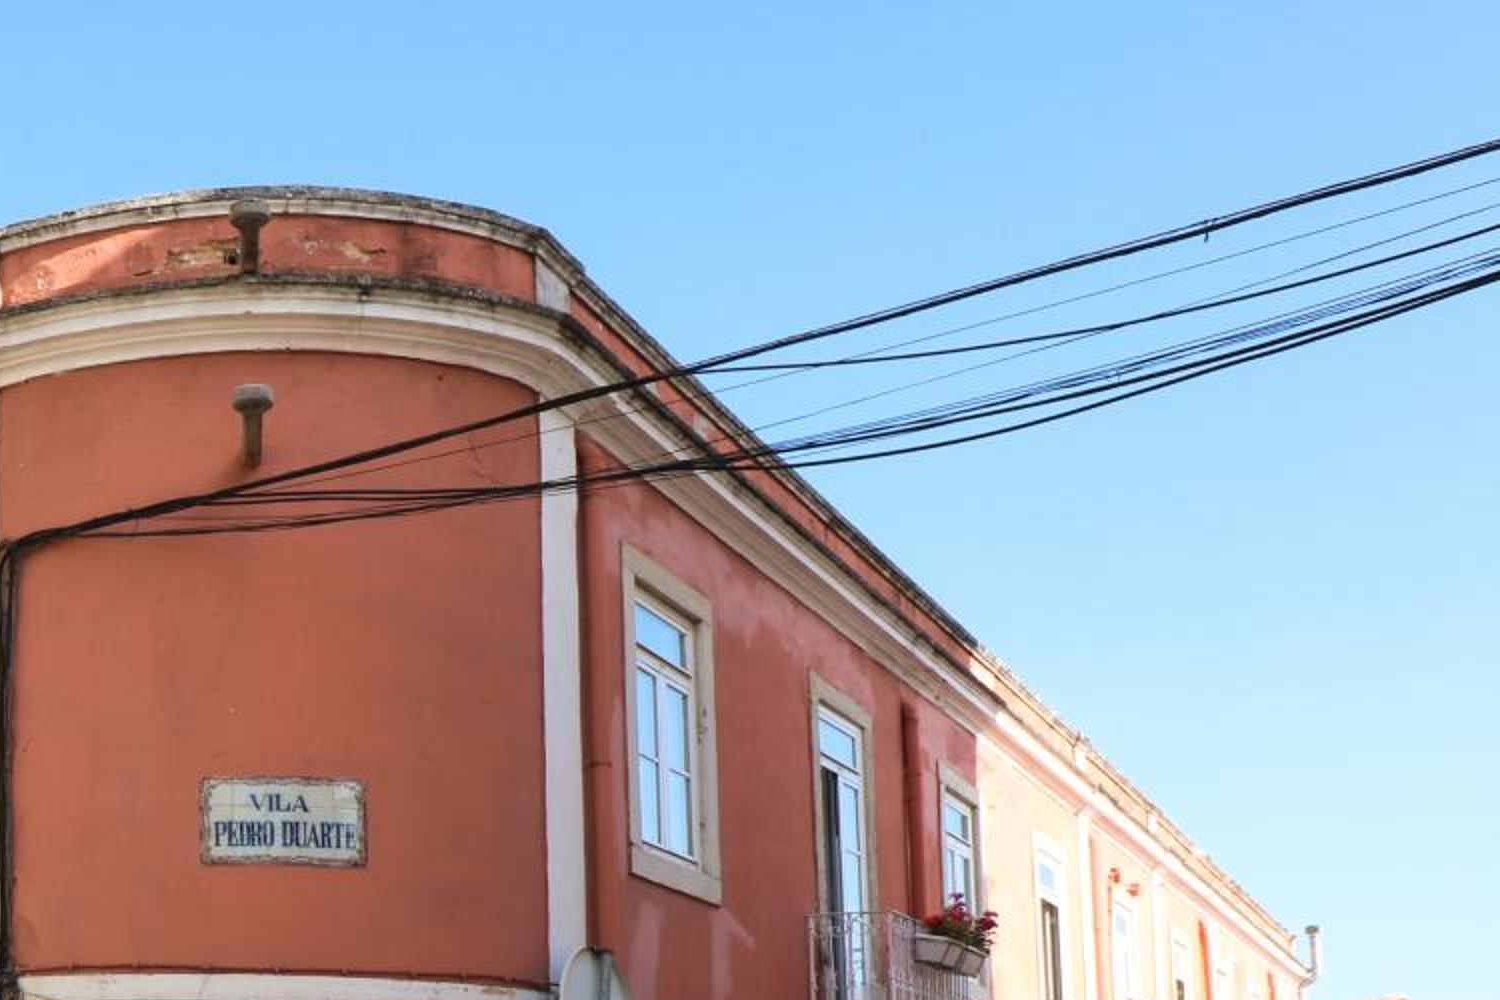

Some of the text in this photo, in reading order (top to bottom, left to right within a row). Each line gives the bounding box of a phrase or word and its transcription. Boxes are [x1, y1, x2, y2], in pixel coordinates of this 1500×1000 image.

[250, 793, 308, 813] VILA
[214, 820, 357, 850] PEDRO DUARTE
